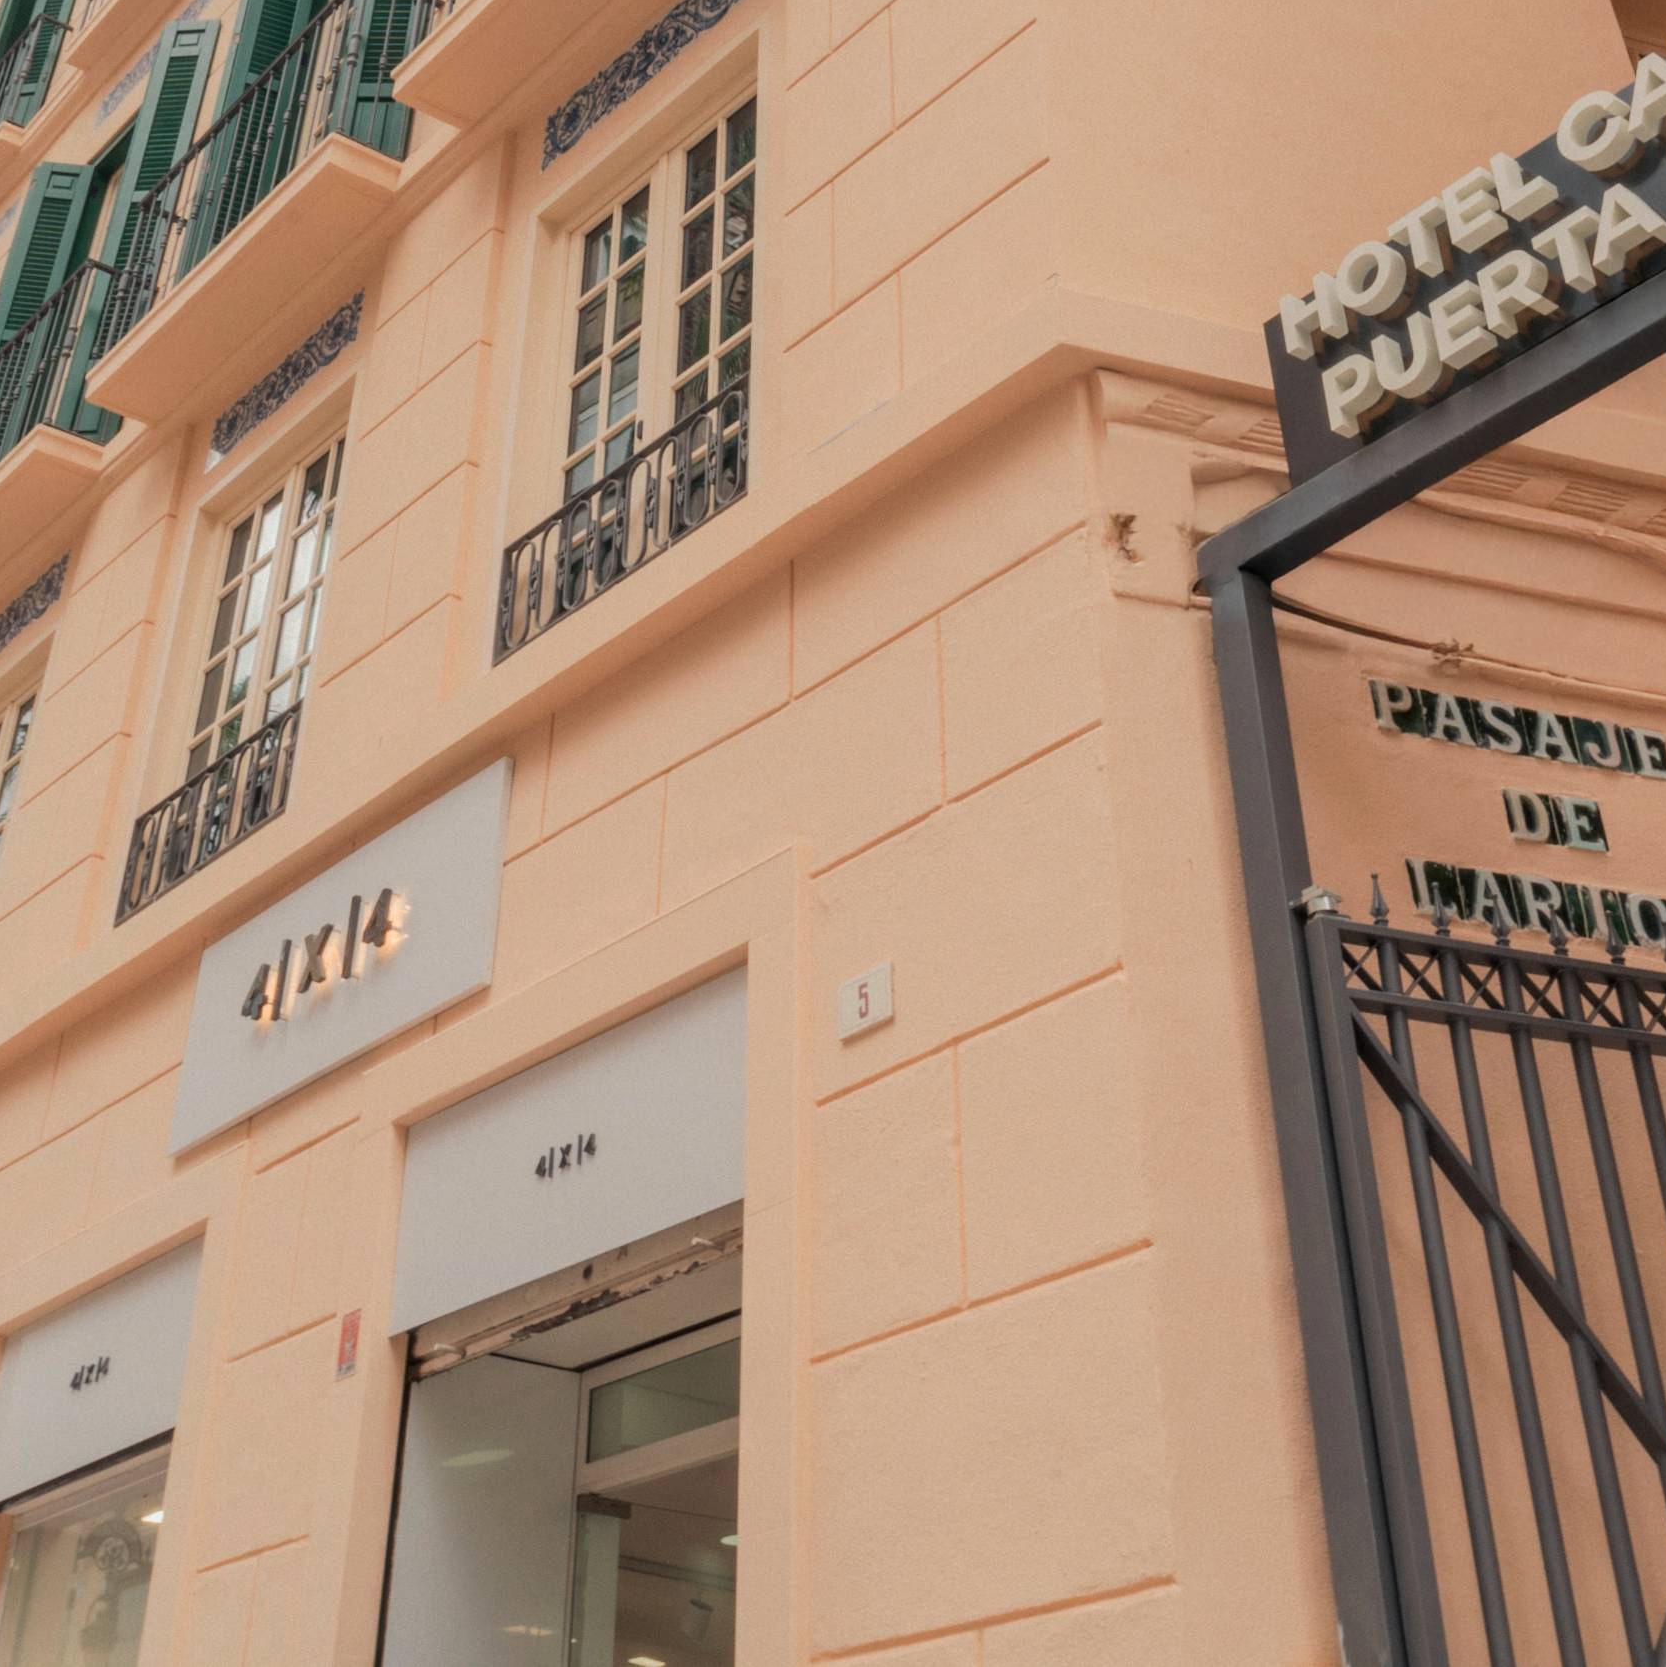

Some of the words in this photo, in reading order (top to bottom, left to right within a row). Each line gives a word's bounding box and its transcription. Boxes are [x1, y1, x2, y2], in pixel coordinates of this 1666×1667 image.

[1279, 152, 1558, 360] HOTEL
[1509, 788, 1609, 853] DE
[858, 981, 869, 1019] 5
